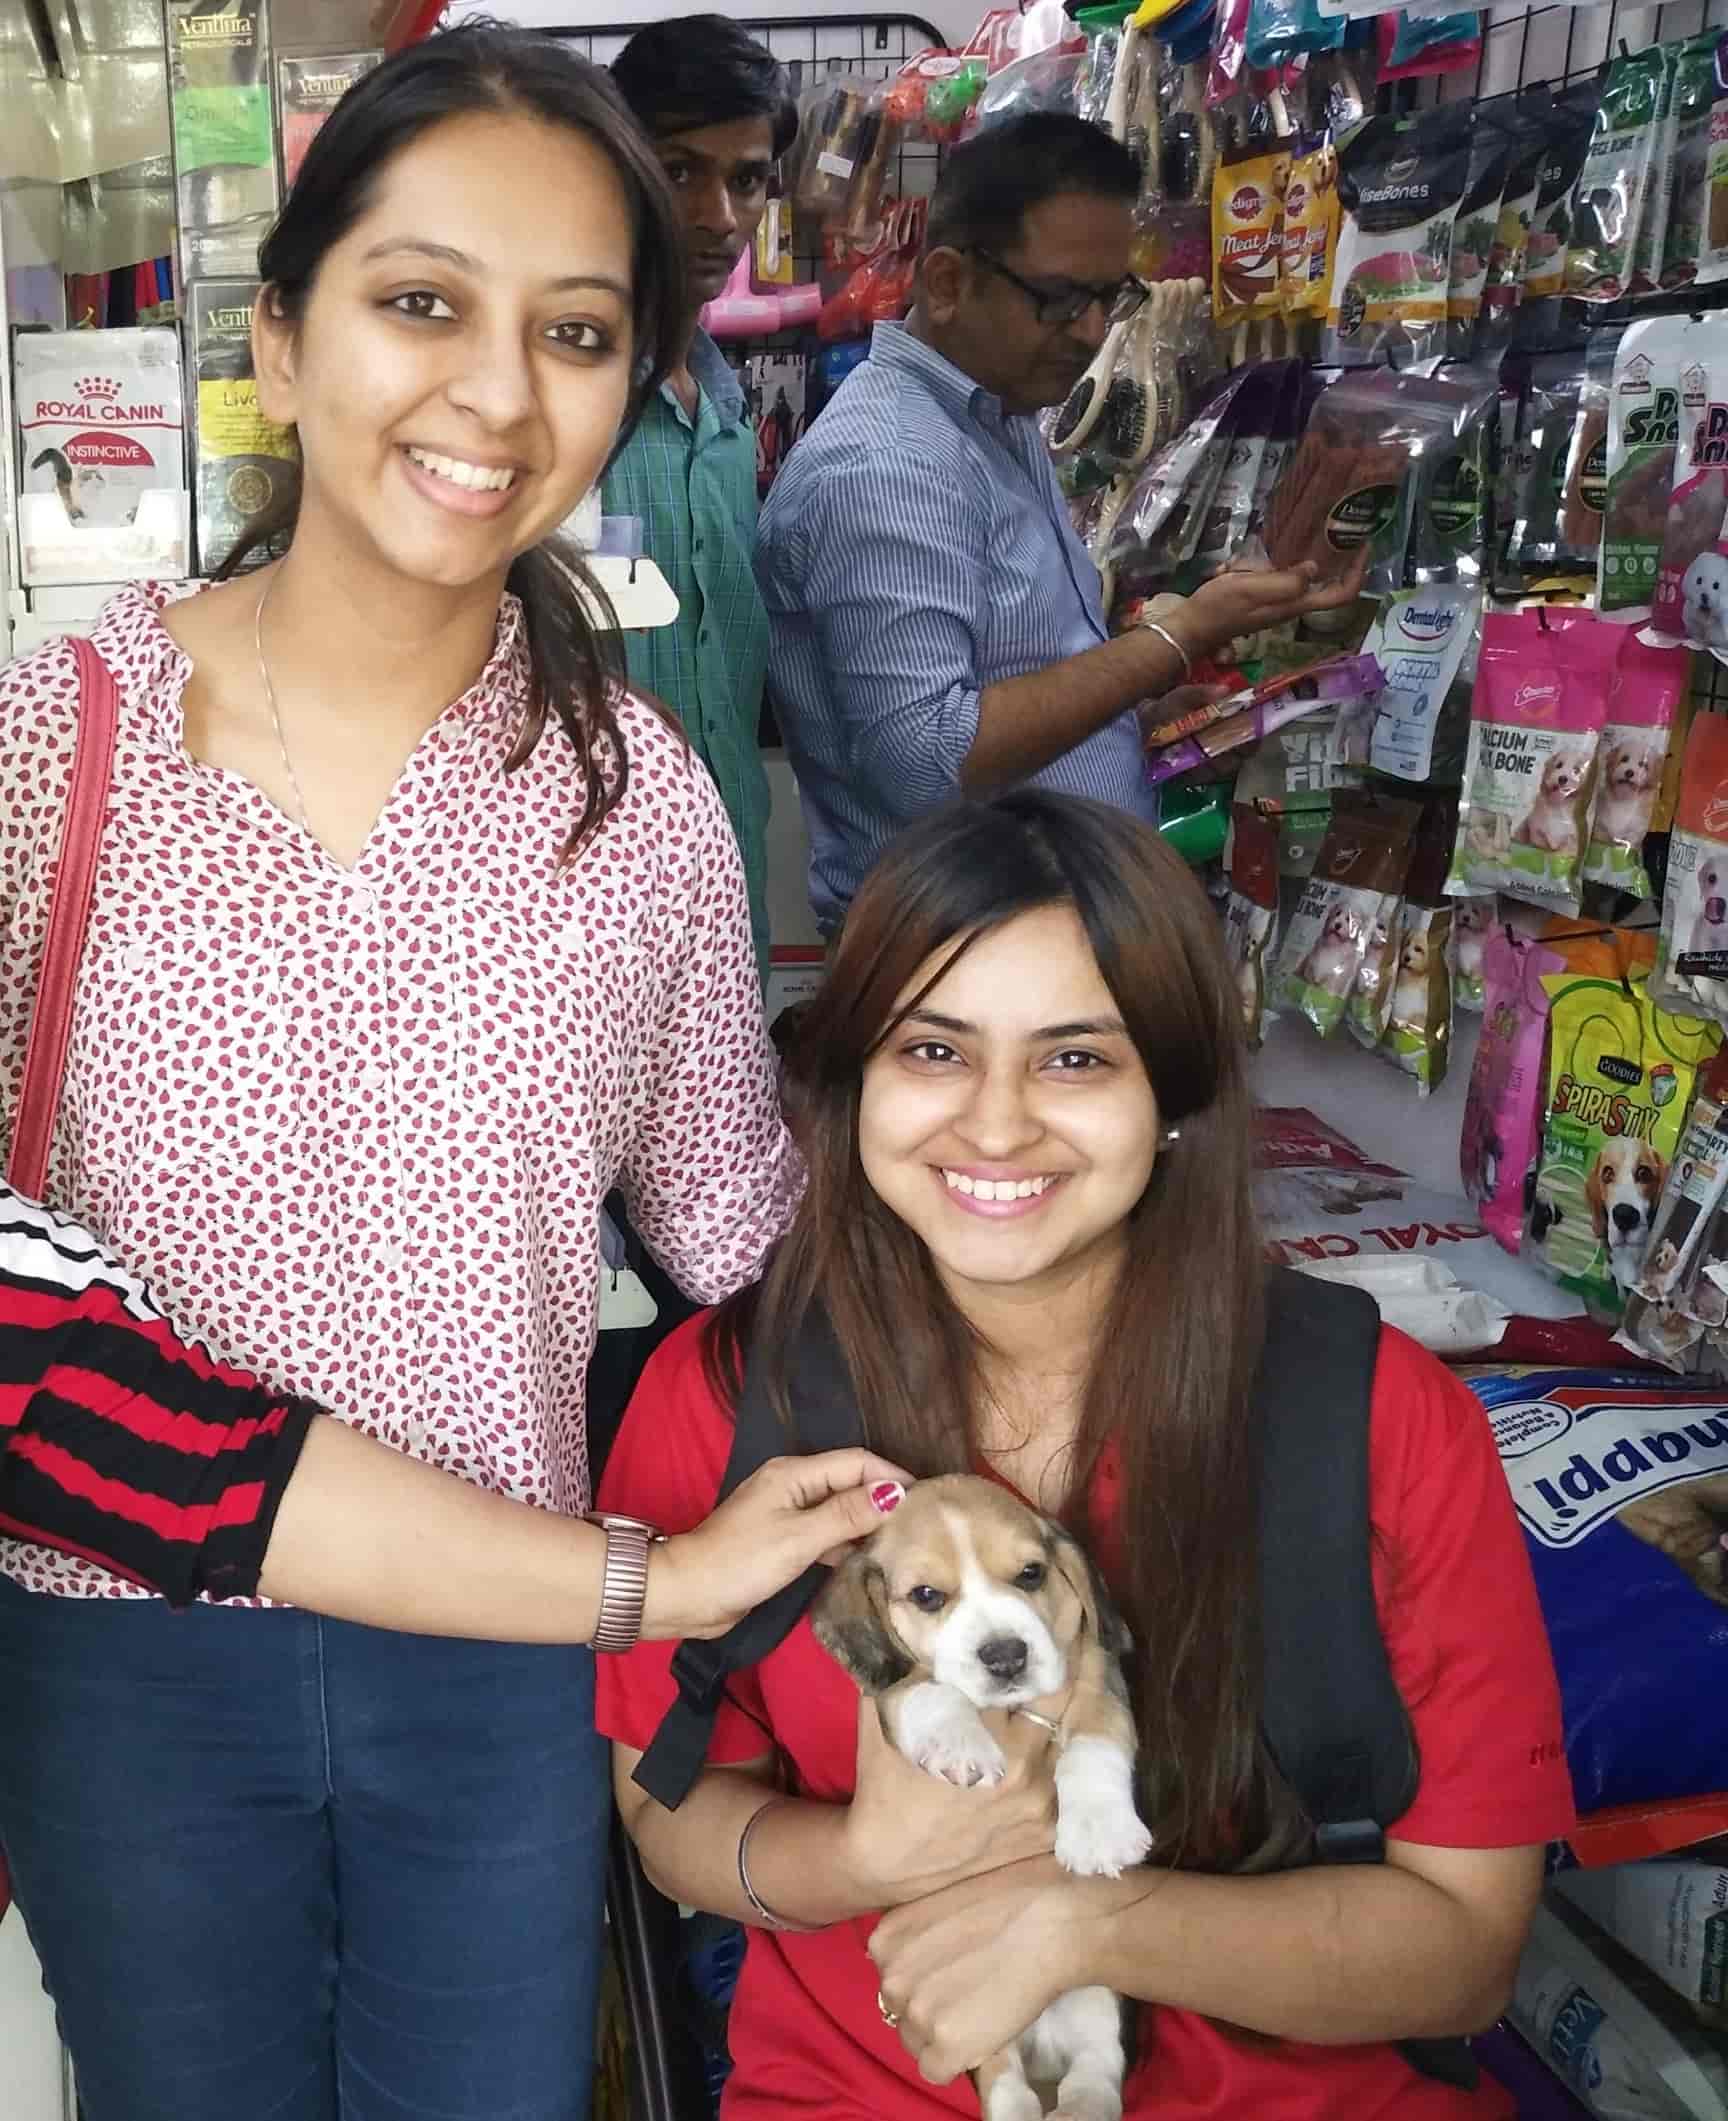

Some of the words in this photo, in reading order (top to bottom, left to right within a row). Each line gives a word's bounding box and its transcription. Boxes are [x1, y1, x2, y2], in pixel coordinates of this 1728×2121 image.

[1222, 233, 1262, 255] Meat
[36, 401, 96, 420] ROYAL
[101, 403, 164, 421] CANIN
[67, 444, 141, 459] INSTINCTIVE
[1494, 751, 1537, 775] BONE
[1600, 1058, 1640, 1083] GOODIES
[1495, 1420, 1561, 1448] Complete
